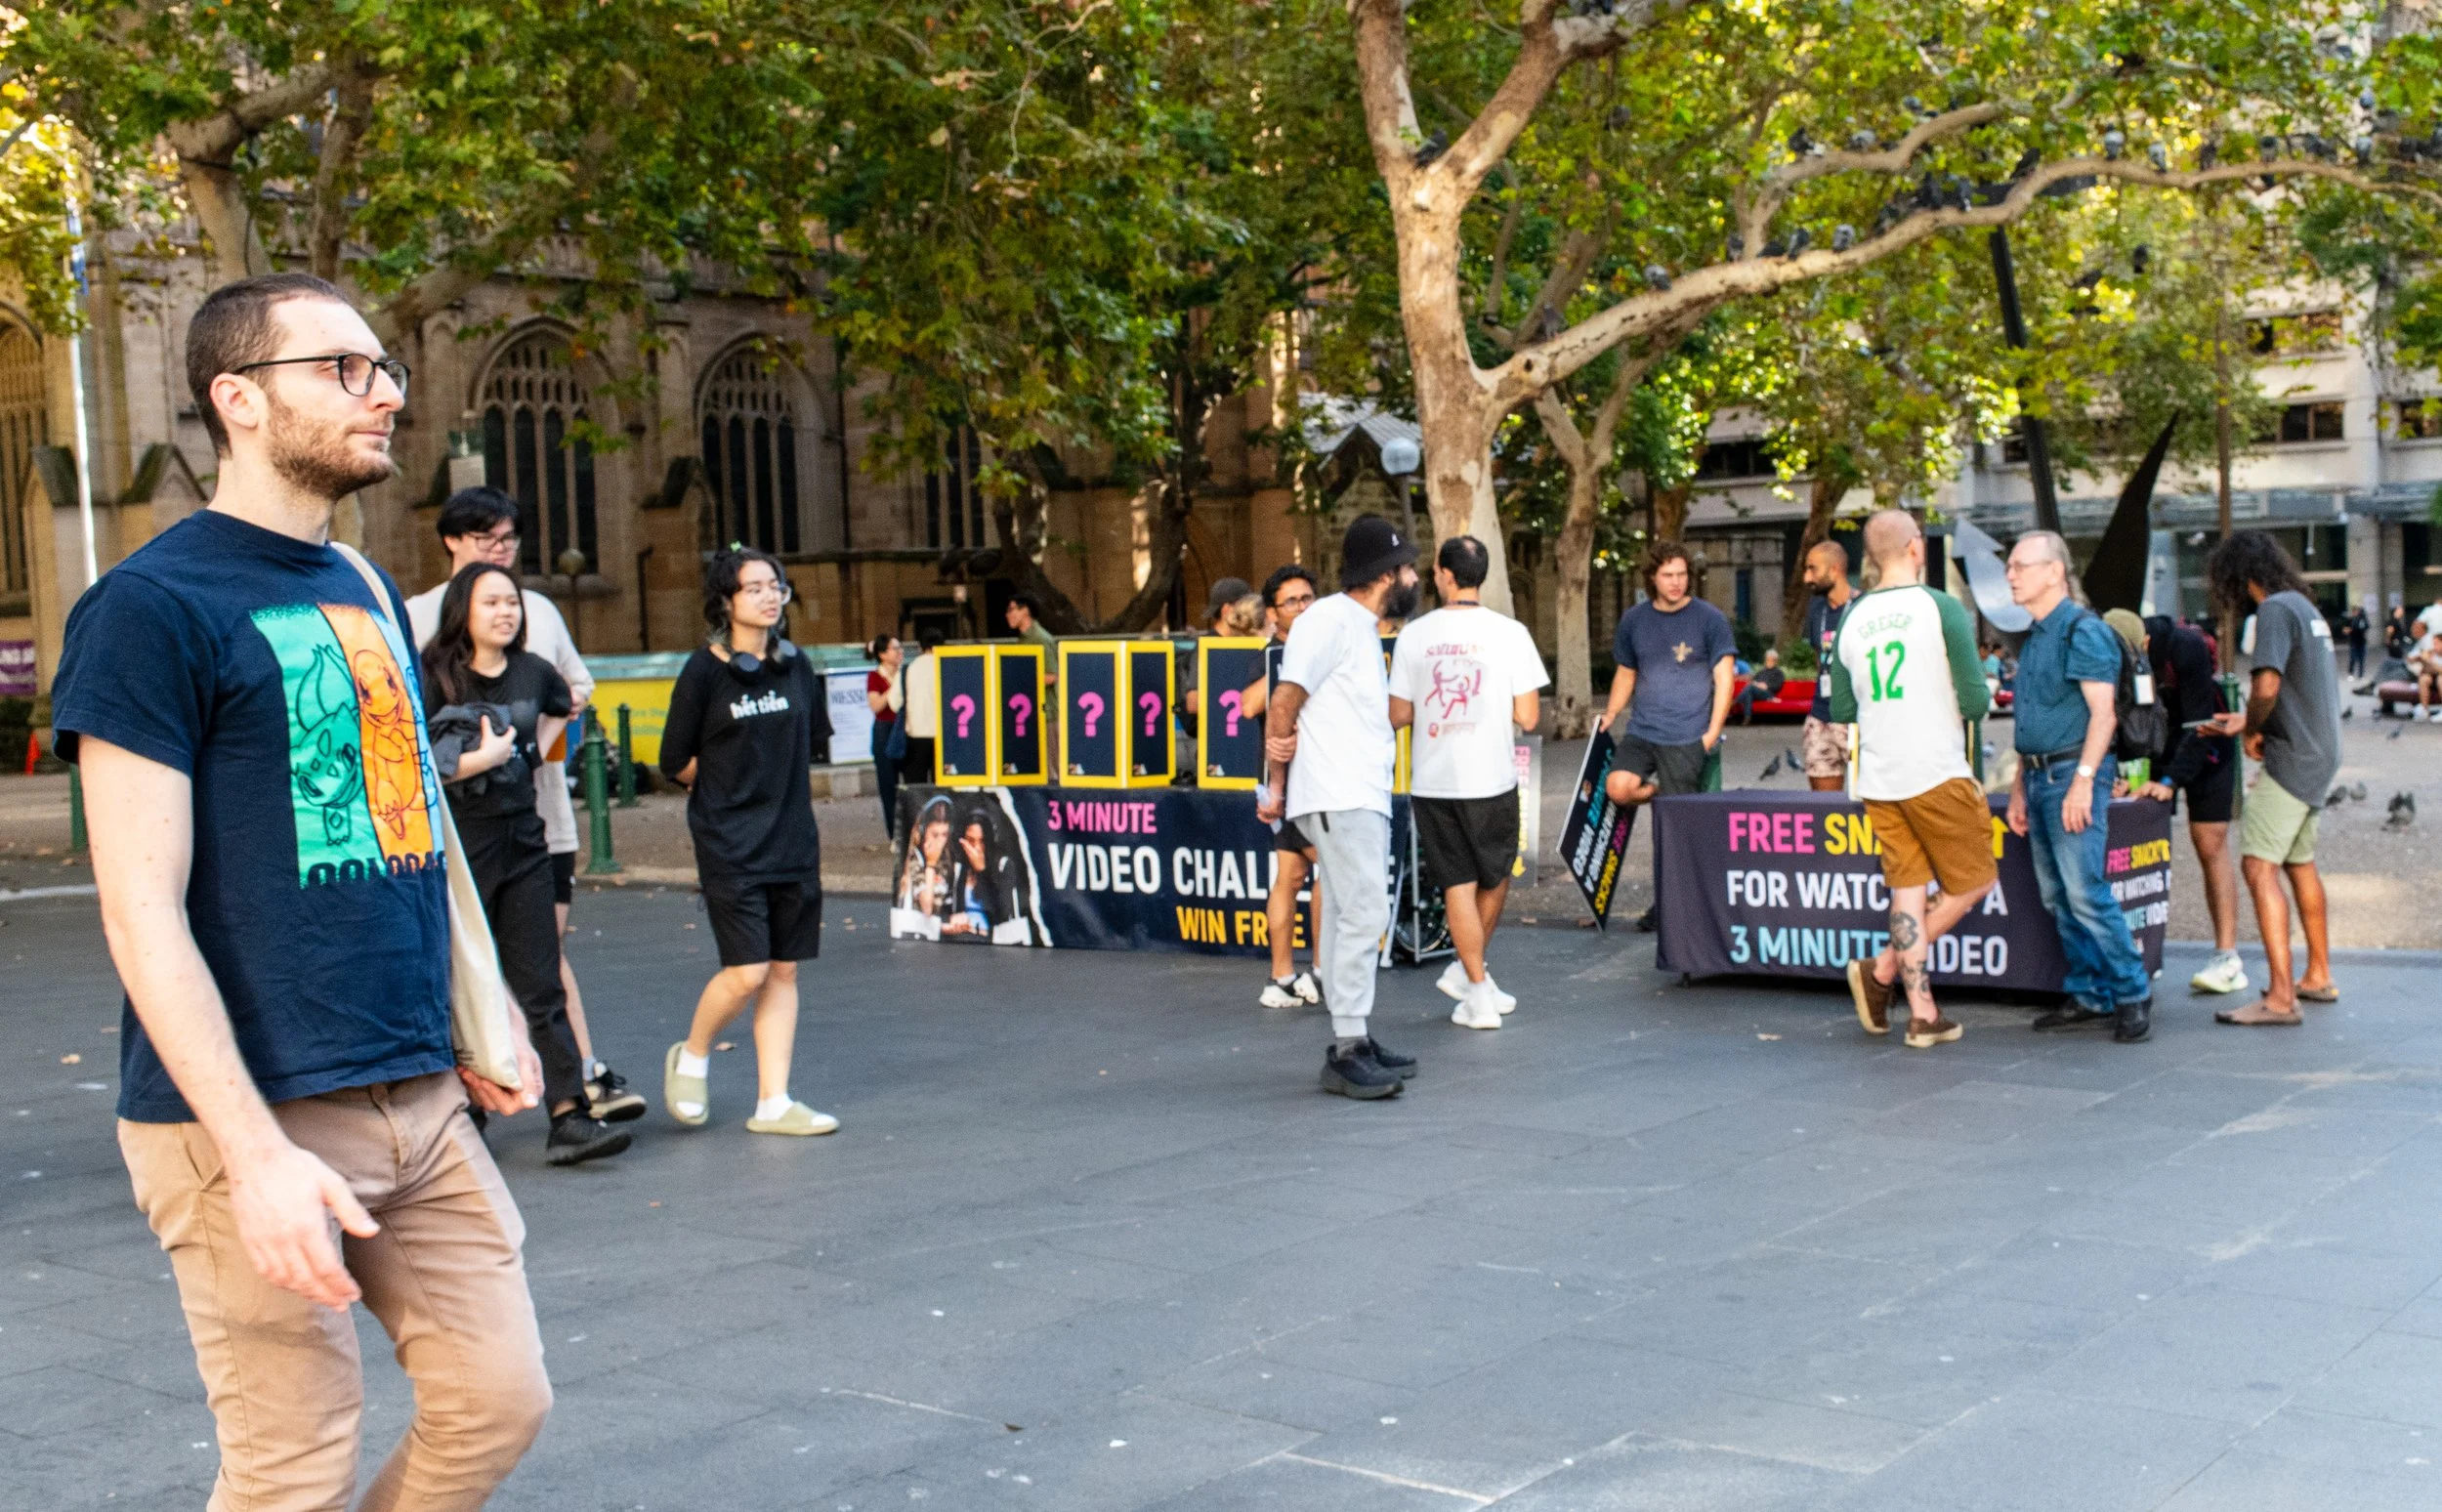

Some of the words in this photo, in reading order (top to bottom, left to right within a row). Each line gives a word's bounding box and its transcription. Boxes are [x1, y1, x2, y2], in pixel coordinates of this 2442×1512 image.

[1866, 641, 1905, 702] 12
[950, 693, 975, 738] ?
[1008, 693, 1032, 737] ?
[1078, 692, 1105, 737] ?
[1139, 692, 1162, 737] ?
[1219, 690, 1242, 736] ?
[1047, 800, 1063, 830] 3
[1066, 801, 1158, 834] MINUTE
[1727, 813, 1816, 855] FREE
[1047, 842, 1160, 894] VIDEO
[1727, 870, 1789, 908] FOR
[1176, 905, 1228, 945] WIN
[1235, 910, 1306, 948] FRE
[1730, 925, 1750, 963] 3
[1926, 934, 2008, 976] IDEO
